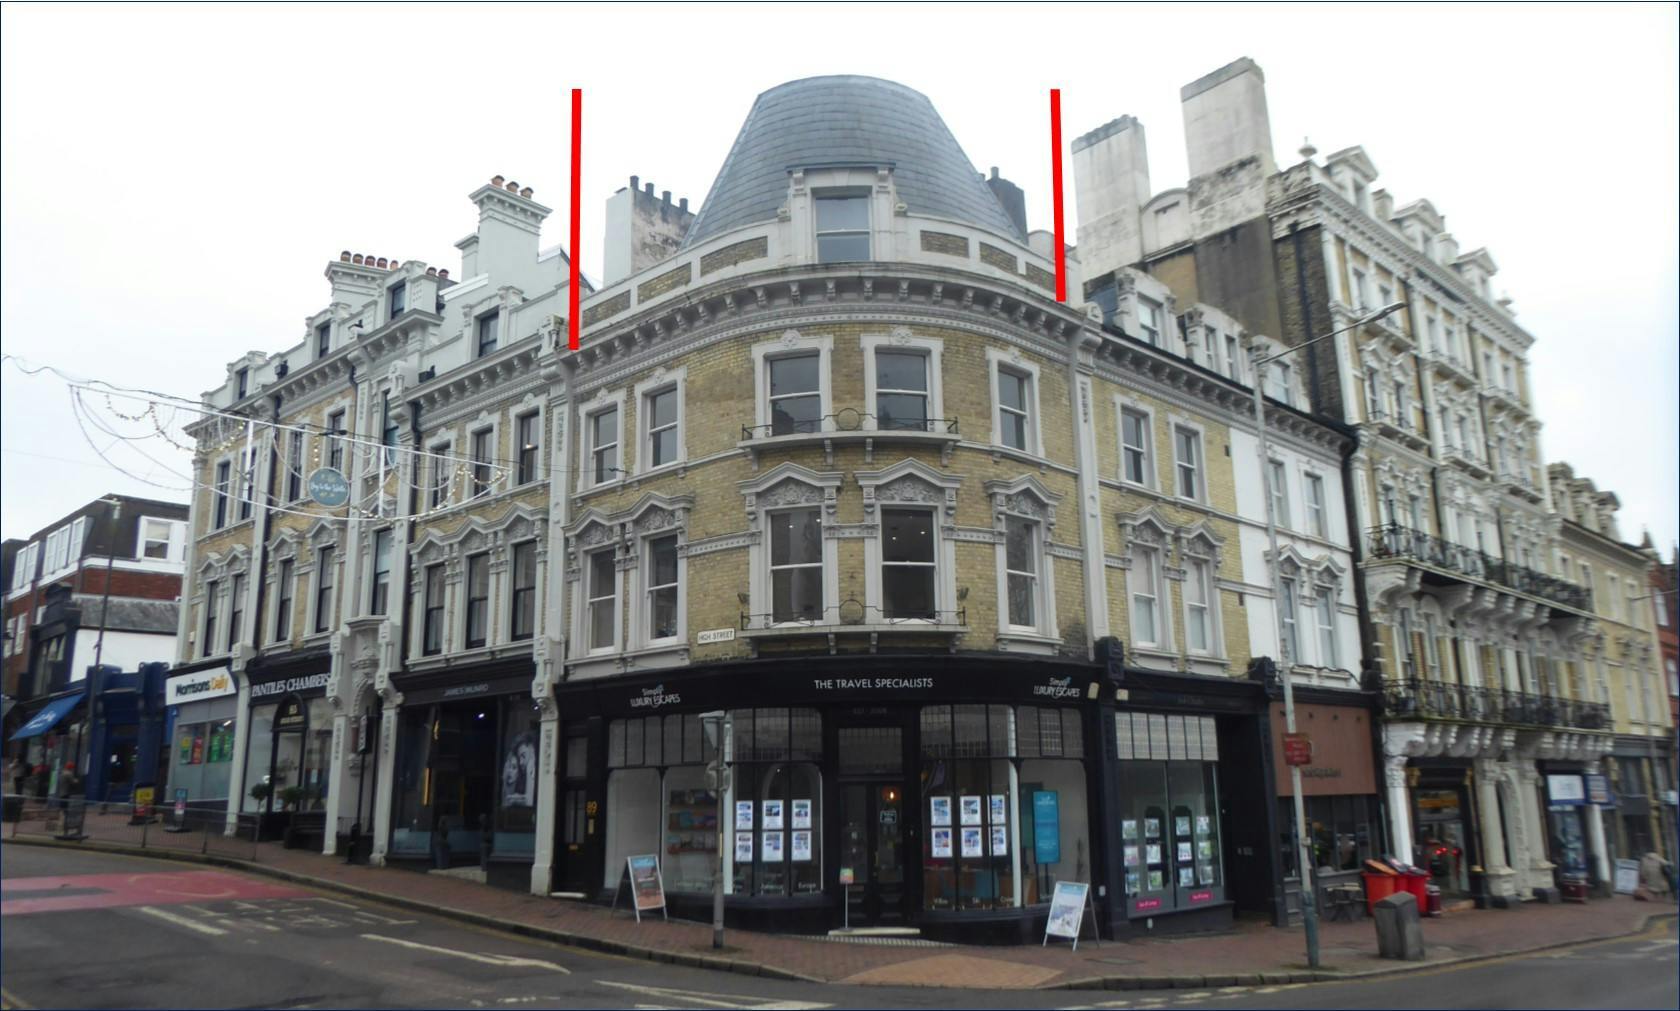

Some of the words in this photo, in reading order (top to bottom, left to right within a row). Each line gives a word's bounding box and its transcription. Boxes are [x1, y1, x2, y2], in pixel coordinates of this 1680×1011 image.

[713, 630, 734, 640] STREET
[175, 679, 210, 696] Morrisons
[211, 674, 229, 693] Daily
[252, 680, 286, 697] PANTILES
[286, 672, 331, 692] CHAMBERS
[814, 680, 832, 689] THE
[836, 679, 872, 688] TRAVEL
[874, 678, 934, 688] SPECIALISTS
[1033, 685, 1056, 697] LUXURY
[1056, 686, 1080, 698] ESCAPES
[630, 697, 653, 707] LUXURY
[653, 694, 680, 704] ESCAPES
